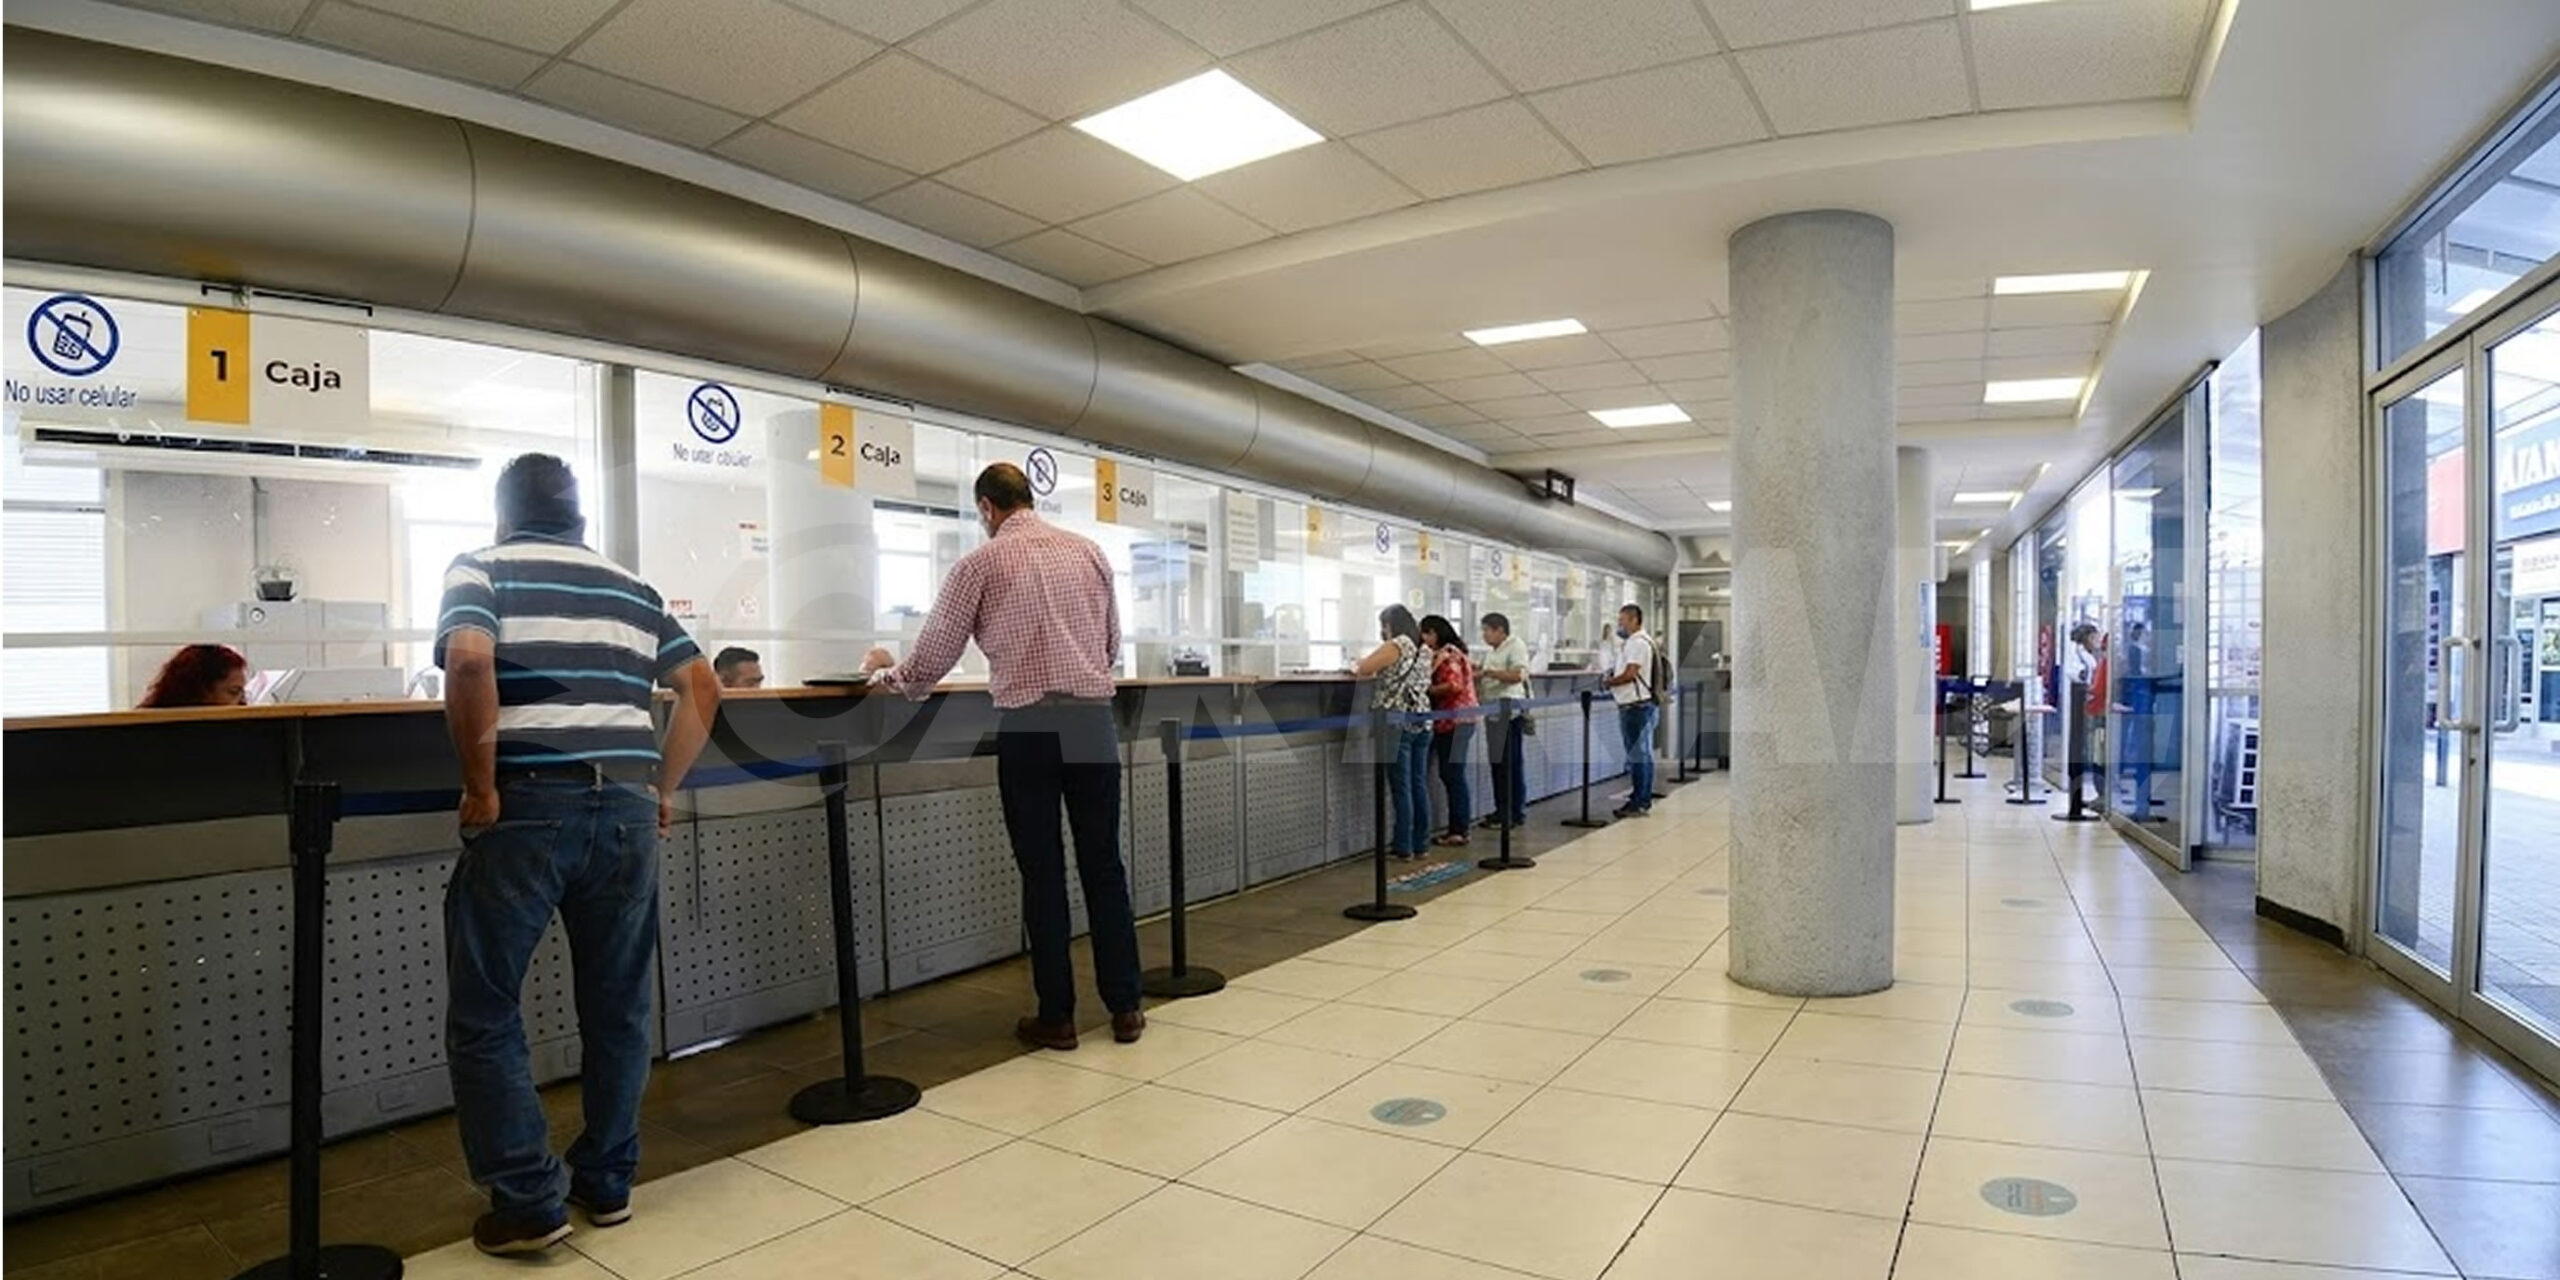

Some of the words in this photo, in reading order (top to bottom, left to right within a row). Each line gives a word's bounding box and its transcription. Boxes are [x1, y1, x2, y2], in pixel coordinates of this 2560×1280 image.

[210, 349, 228, 383] 1
[264, 359, 342, 393] Caja
[4, 379, 30, 403] No
[36, 386, 75, 405] usar
[79, 385, 137, 408] celular
[831, 435, 845, 456] 2
[860, 442, 901, 465] Caja
[1103, 482, 1112, 502] 3
[1119, 487, 1148, 508] Caja
